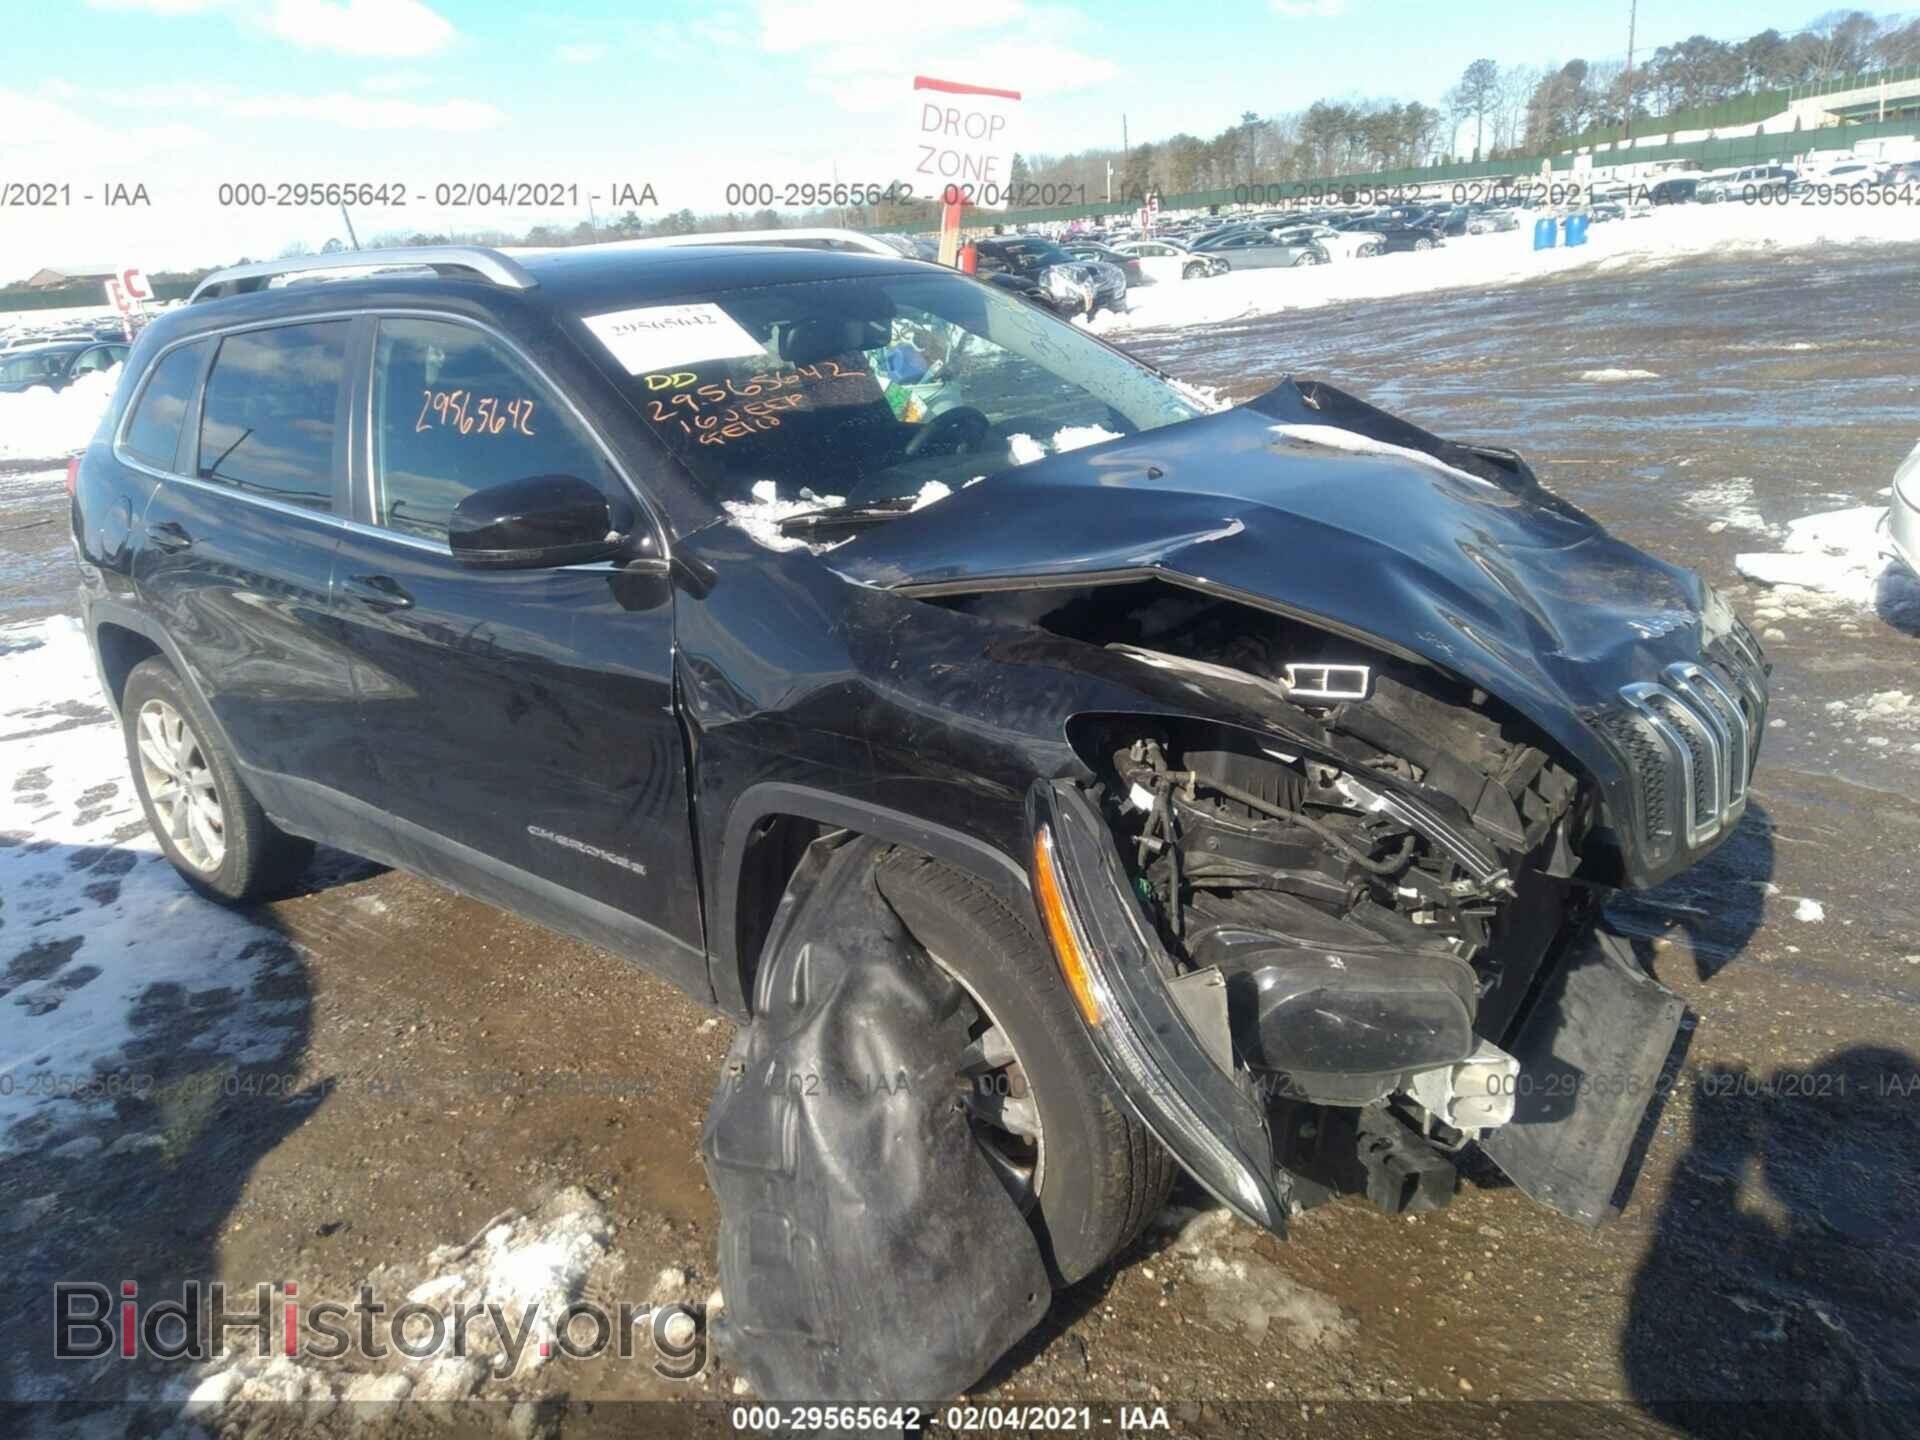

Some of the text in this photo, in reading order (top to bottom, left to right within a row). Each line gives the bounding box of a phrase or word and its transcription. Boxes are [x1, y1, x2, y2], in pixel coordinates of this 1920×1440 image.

[921, 103, 1006, 141] DROP
[916, 144, 1000, 184] ZONE
[123, 268, 146, 298] C
[644, 372, 698, 390] DD
[649, 361, 866, 421] 29565642
[415, 389, 536, 436] 29565642
[680, 414, 718, 433] 16
